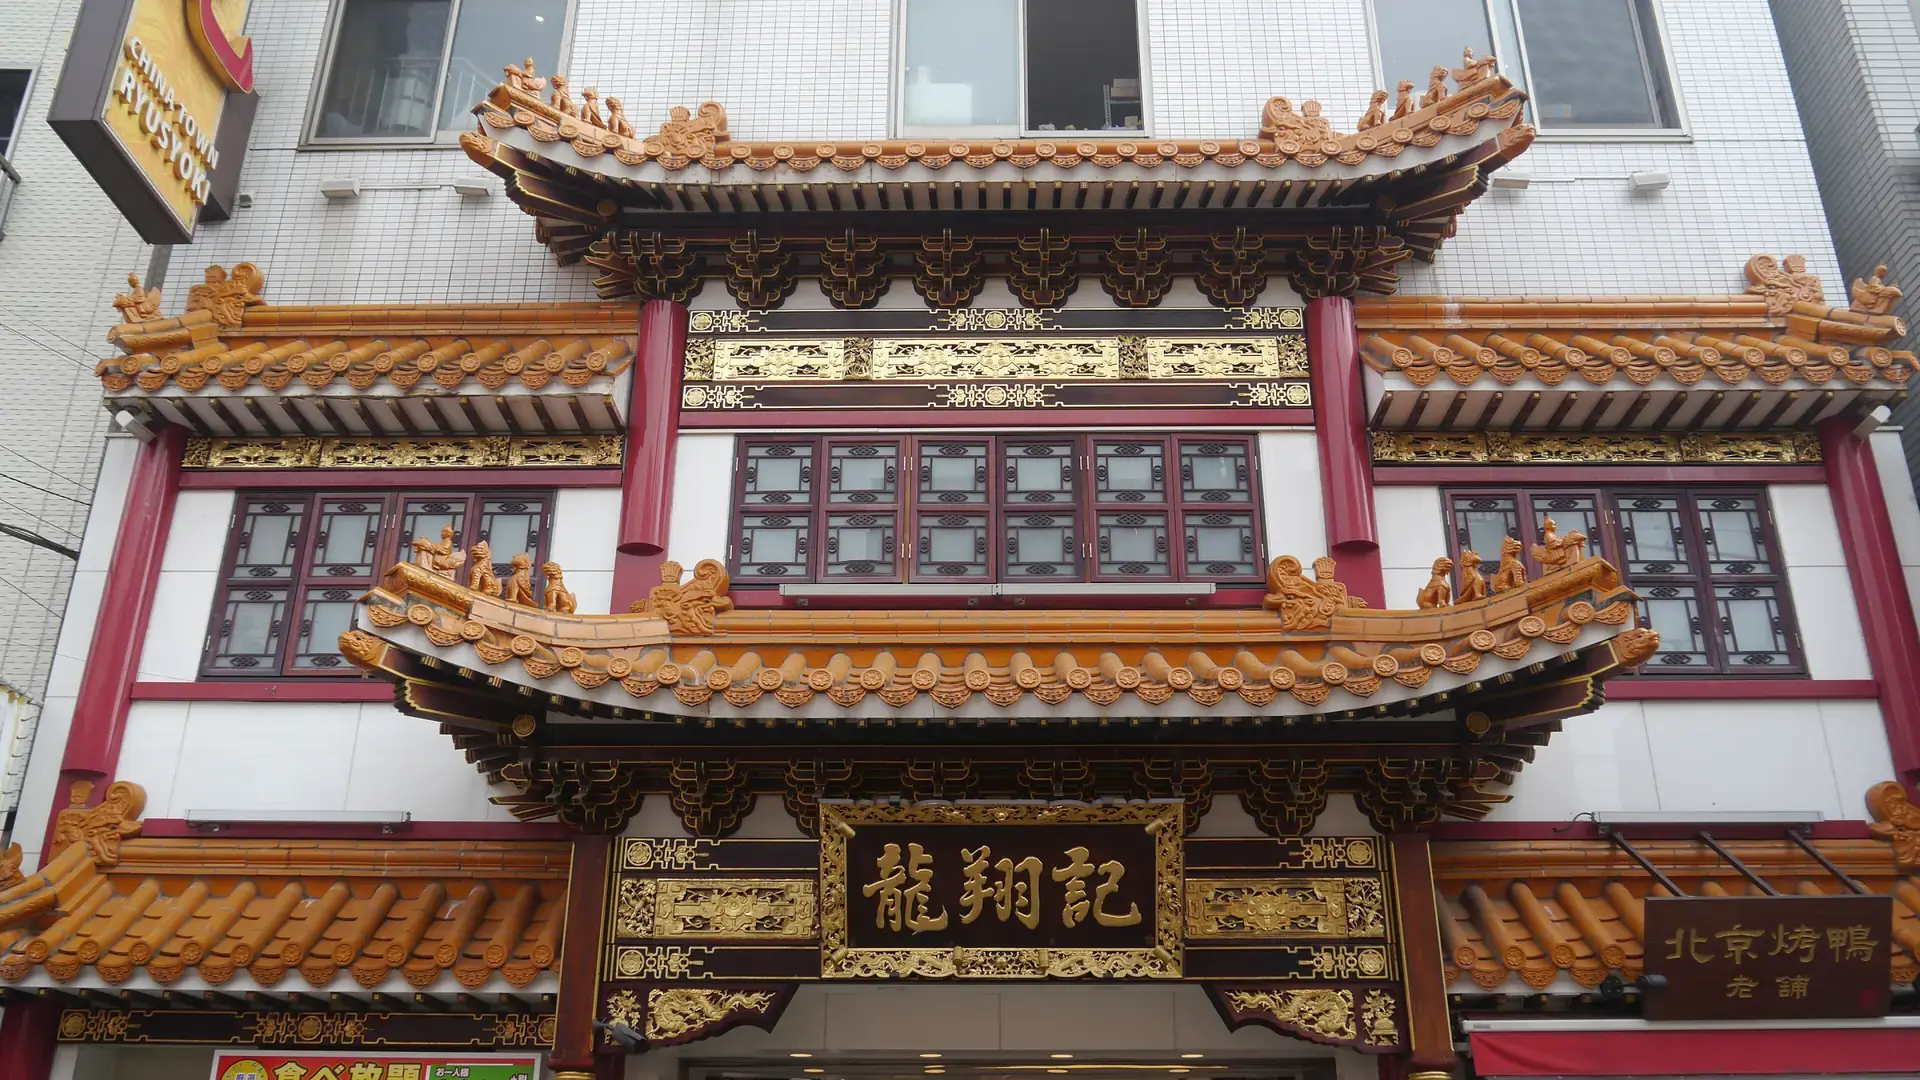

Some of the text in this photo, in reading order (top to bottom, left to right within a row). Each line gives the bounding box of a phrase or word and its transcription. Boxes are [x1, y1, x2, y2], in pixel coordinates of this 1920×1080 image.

[120, 69, 210, 205] RYUSYOKI
[130, 36, 175, 111] CHINA
[178, 103, 219, 170] TOWN
[862, 842, 1142, 936] 龍翔記
[1664, 923, 1879, 965] 北京烤鴨
